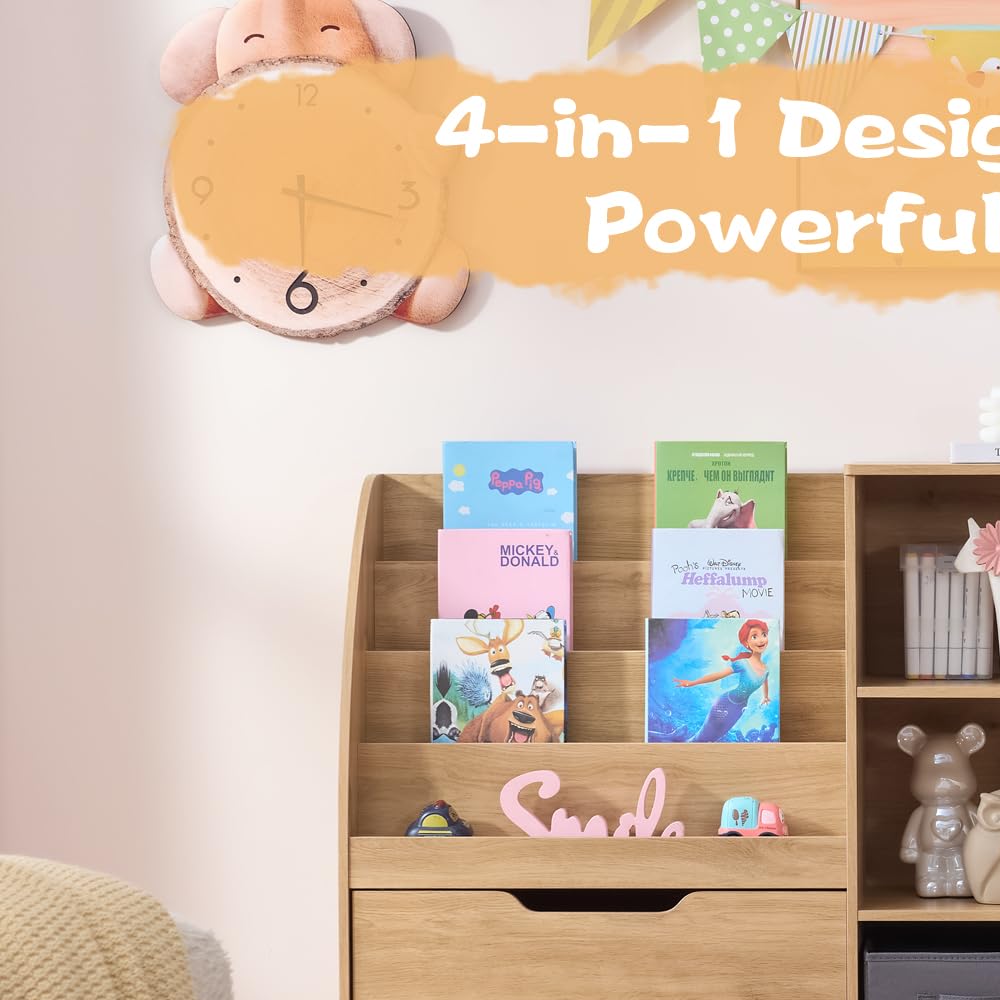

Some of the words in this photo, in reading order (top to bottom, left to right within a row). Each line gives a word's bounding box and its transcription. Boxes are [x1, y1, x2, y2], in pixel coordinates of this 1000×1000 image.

[285, 270, 319, 315] 6
[491, 471, 523, 492] Peppa
[524, 471, 542, 490] Pig
[704, 470, 720, 482] ЧЕМ
[721, 470, 732, 482] ОН
[500, 556, 559, 567] DONALD
[681, 572, 768, 588] Heffalump
[742, 588, 774, 598] MOVIE
